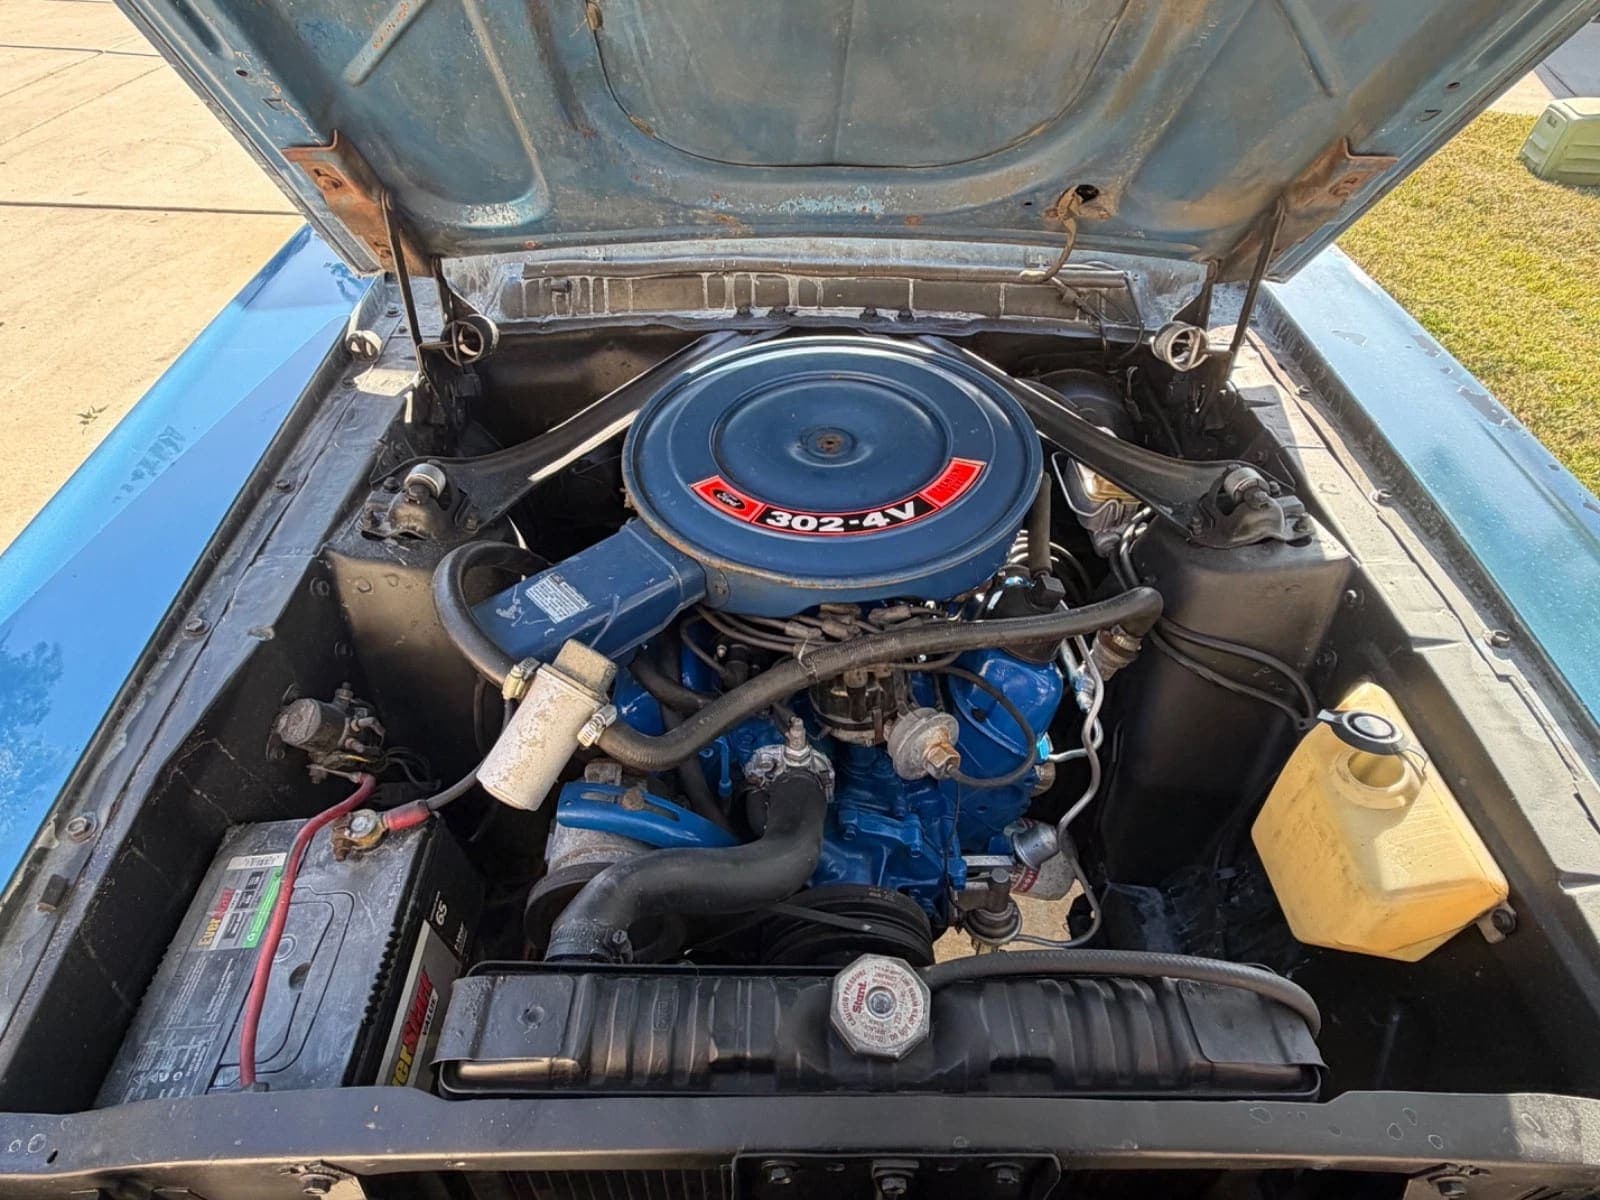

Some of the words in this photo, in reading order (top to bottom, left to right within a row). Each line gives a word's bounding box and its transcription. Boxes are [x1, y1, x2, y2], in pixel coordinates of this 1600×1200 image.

[766, 501, 916, 532] 302-4V
[436, 900, 447, 925] 65
[853, 981, 867, 1014] Stant
